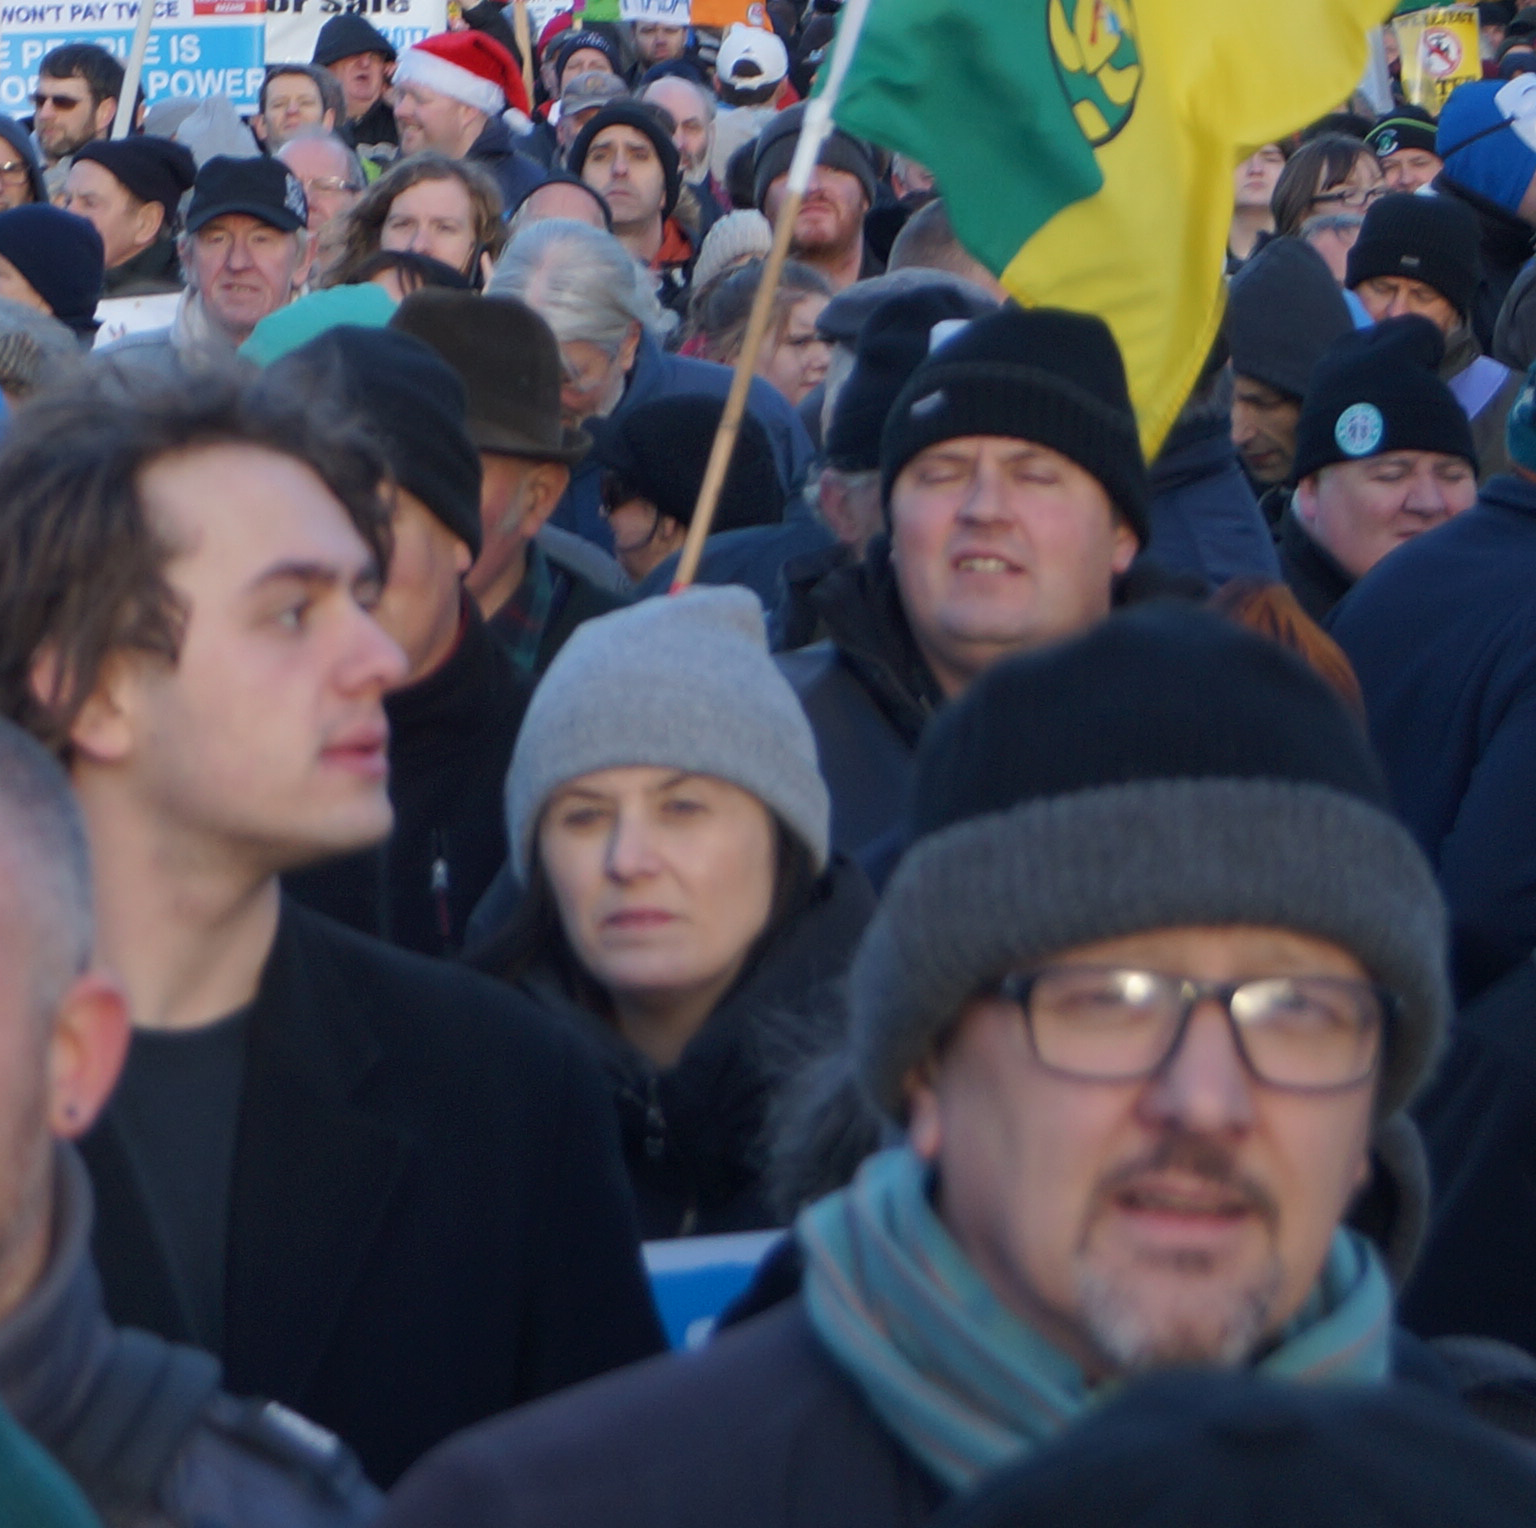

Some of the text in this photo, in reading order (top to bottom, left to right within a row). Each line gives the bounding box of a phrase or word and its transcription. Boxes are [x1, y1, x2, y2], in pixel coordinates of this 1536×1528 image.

[70, 1, 108, 22] PAY
[114, 0, 180, 21] TWCE
[22, 35, 161, 66] PEPLE
[169, 34, 201, 64] IS
[148, 67, 266, 100] POWER
